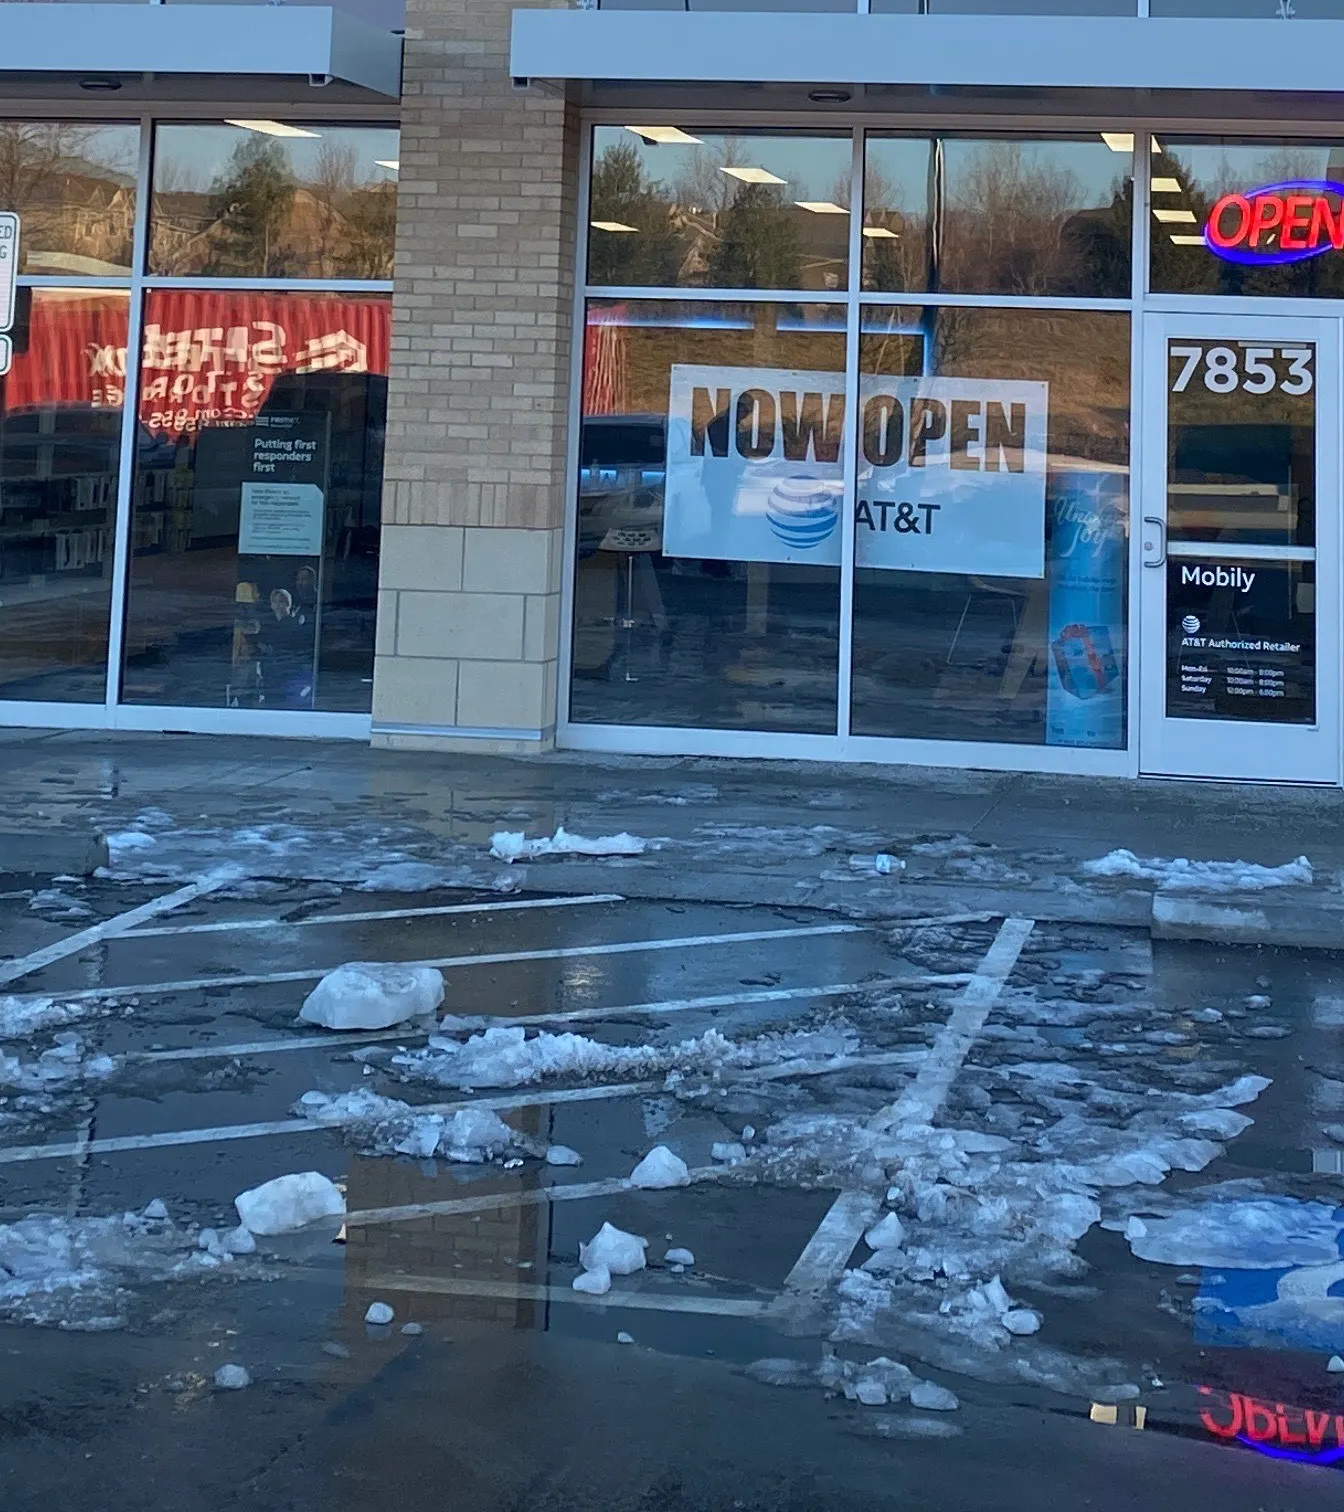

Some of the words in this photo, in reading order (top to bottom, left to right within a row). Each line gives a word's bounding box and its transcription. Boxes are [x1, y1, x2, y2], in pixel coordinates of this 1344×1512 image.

[1170, 346, 1313, 395] 7853
[690, 387, 846, 463] NOW
[862, 394, 1026, 474] OPEN
[255, 438, 292, 451] Putting
[295, 439, 316, 450] first
[254, 451, 312, 462] responders
[253, 462, 275, 472] first
[855, 500, 941, 535] AT&T
[1181, 566, 1256, 593] Mobily
[1181, 637, 1207, 647] AT&T
[1208, 638, 1261, 651] Authorized
[1263, 641, 1301, 653] Retailer
[1181, 684, 1207, 694] Sunday
